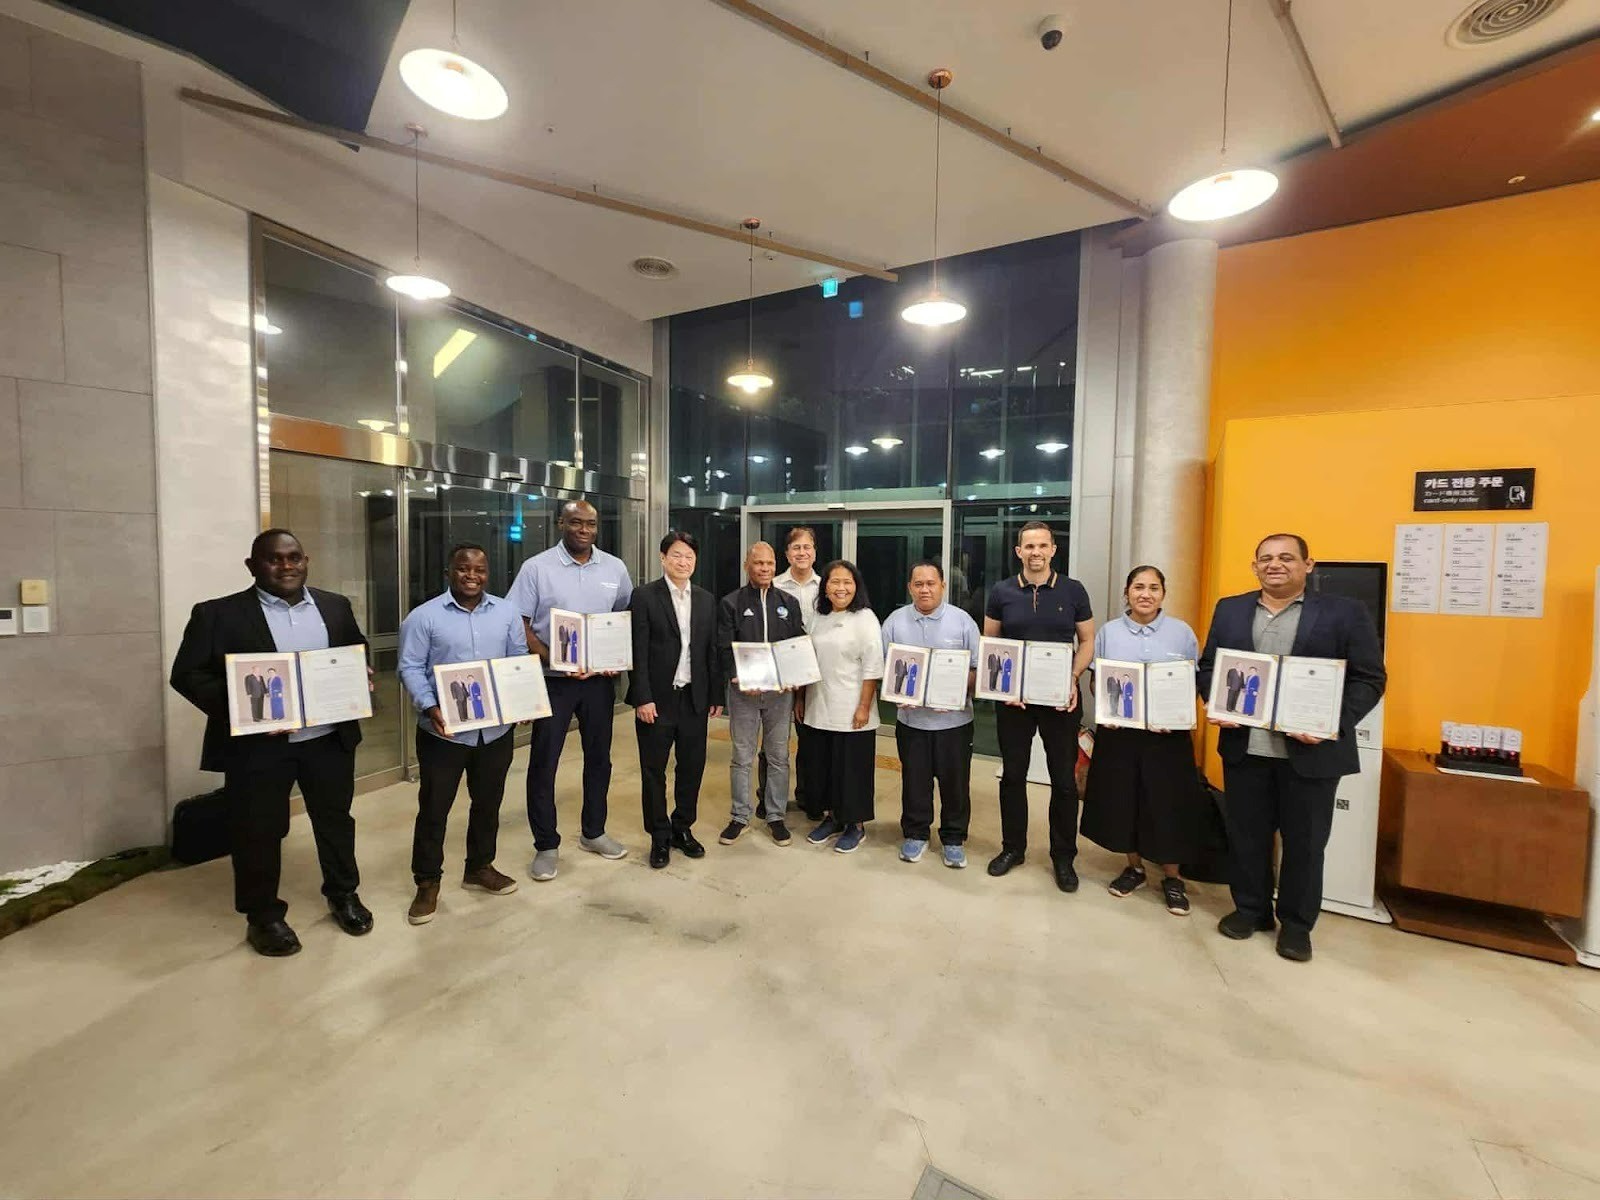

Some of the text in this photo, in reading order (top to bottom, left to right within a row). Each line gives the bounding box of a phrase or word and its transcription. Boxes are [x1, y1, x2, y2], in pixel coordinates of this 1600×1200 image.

[1424, 476, 1504, 489] 카드 전용 주문
